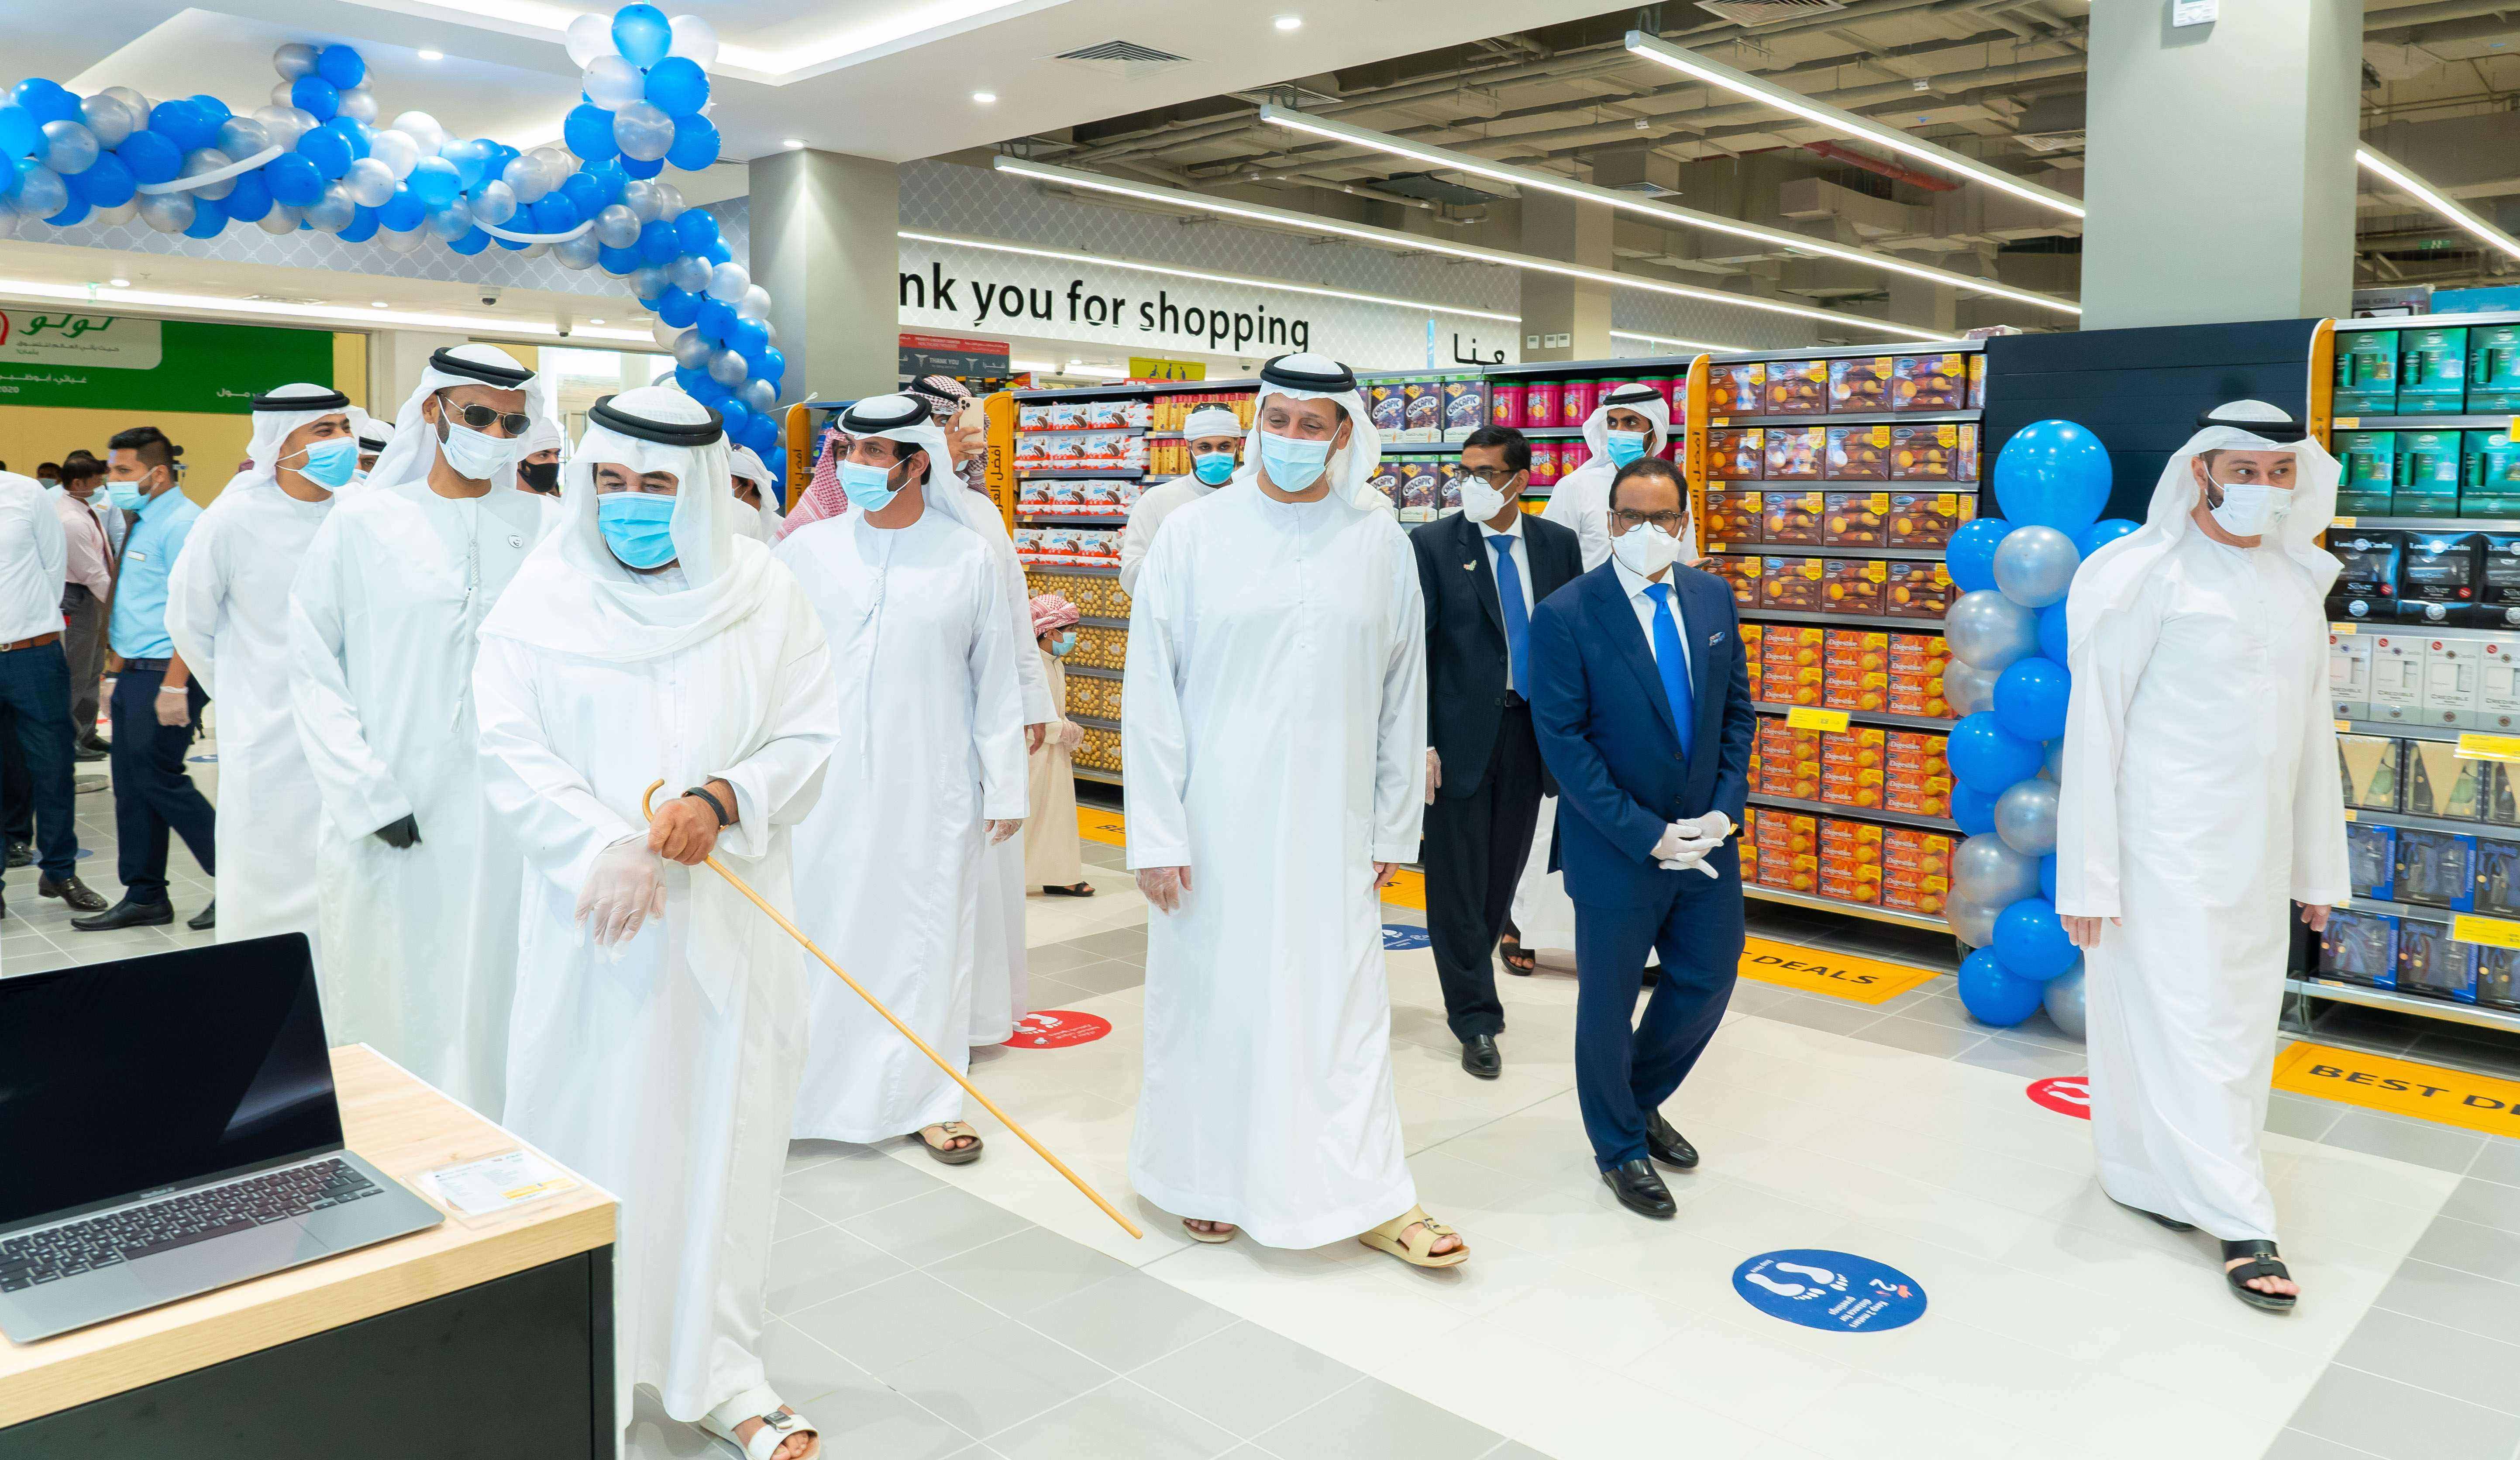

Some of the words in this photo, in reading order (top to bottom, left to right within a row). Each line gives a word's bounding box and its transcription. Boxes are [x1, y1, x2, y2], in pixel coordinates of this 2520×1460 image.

[972, 281, 1052, 327] you
[1067, 279, 1126, 328] for
[1140, 291, 1308, 353] shopping
[1827, 640, 1857, 648] Digestive
[1893, 644, 1923, 653] Digestive
[1766, 654, 1793, 662] Digestive
[1827, 658, 1856, 667] Digestive
[1893, 663, 1922, 672] Digestive
[1766, 674, 1793, 682] Digestive
[1827, 678, 1856, 687] Digestive
[1893, 683, 1922, 692] Digestive
[1765, 692, 1793, 700] Digestive
[1827, 697, 1856, 706] Digestive
[1892, 702, 1921, 710] Digestive
[1825, 735, 1854, 744] Digestive
[1890, 741, 1919, 751] Digestive
[1824, 754, 1853, 763] Digestive
[1763, 765, 1791, 775] Digestive
[1890, 761, 1919, 770] Digestive
[1824, 773, 1853, 782] Digestive
[1763, 784, 1790, 792] Digestive
[1889, 780, 1918, 790] Digestive
[1823, 792, 1852, 801] Digestive
[1888, 800, 1918, 809] Digestive
[1760, 820, 1786, 829] Digestive
[1823, 830, 1852, 839] Digestive
[1759, 837, 1786, 846] Digestive
[1887, 840, 1917, 849] Digestive
[1823, 848, 1852, 857] Digestive
[1761, 857, 1789, 865] Digestive
[1887, 857, 1916, 867] Digestive
[1823, 867, 1852, 877] Digestive
[1761, 874, 1788, 883] Digestive
[1886, 878, 1916, 888] Digestive
[1823, 886, 1851, 895] Digestive
[1886, 896, 1916, 906] Digestive
[1751, 955, 1880, 984] DEALS
[2308, 1064, 2450, 1098] BEST
